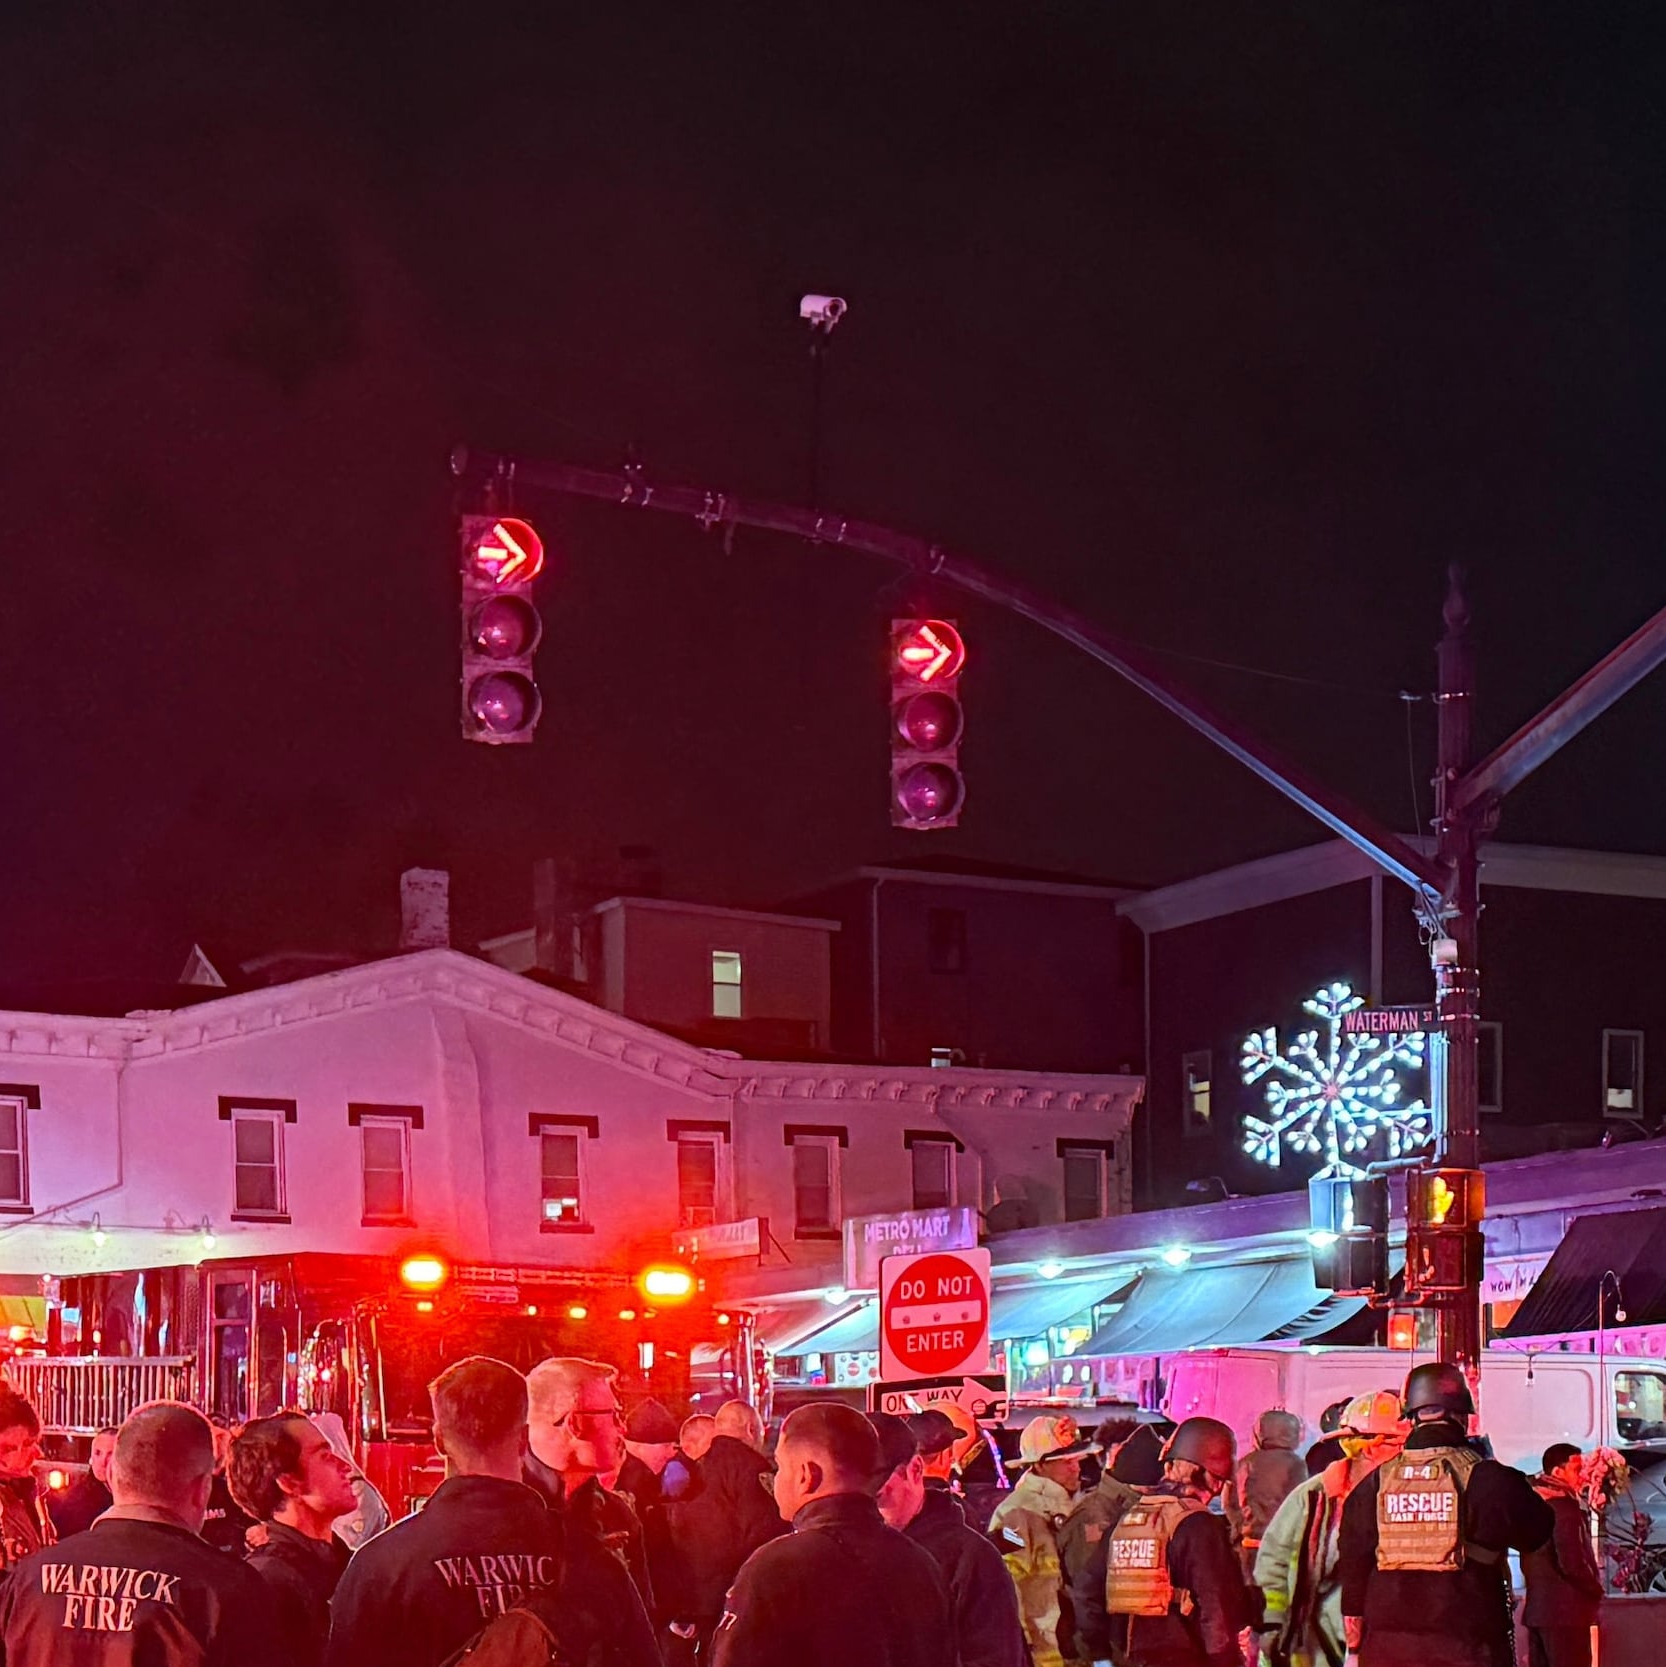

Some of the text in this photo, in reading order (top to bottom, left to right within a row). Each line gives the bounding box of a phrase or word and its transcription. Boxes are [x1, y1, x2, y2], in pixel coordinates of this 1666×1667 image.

[1346, 1011, 1432, 1031] WATERMAN ST
[865, 1215, 950, 1243] METRO MART
[900, 1276, 973, 1300] DO NOT
[906, 1331, 964, 1353] ENTER
[887, 1389, 963, 1412] ON WAY
[1387, 1492, 1453, 1514] RESCUE
[1391, 1513, 1414, 1522] TASK
[434, 1555, 557, 1588] WARWIC
[42, 1564, 181, 1604] WARWICK
[62, 1594, 136, 1632] FIRE
